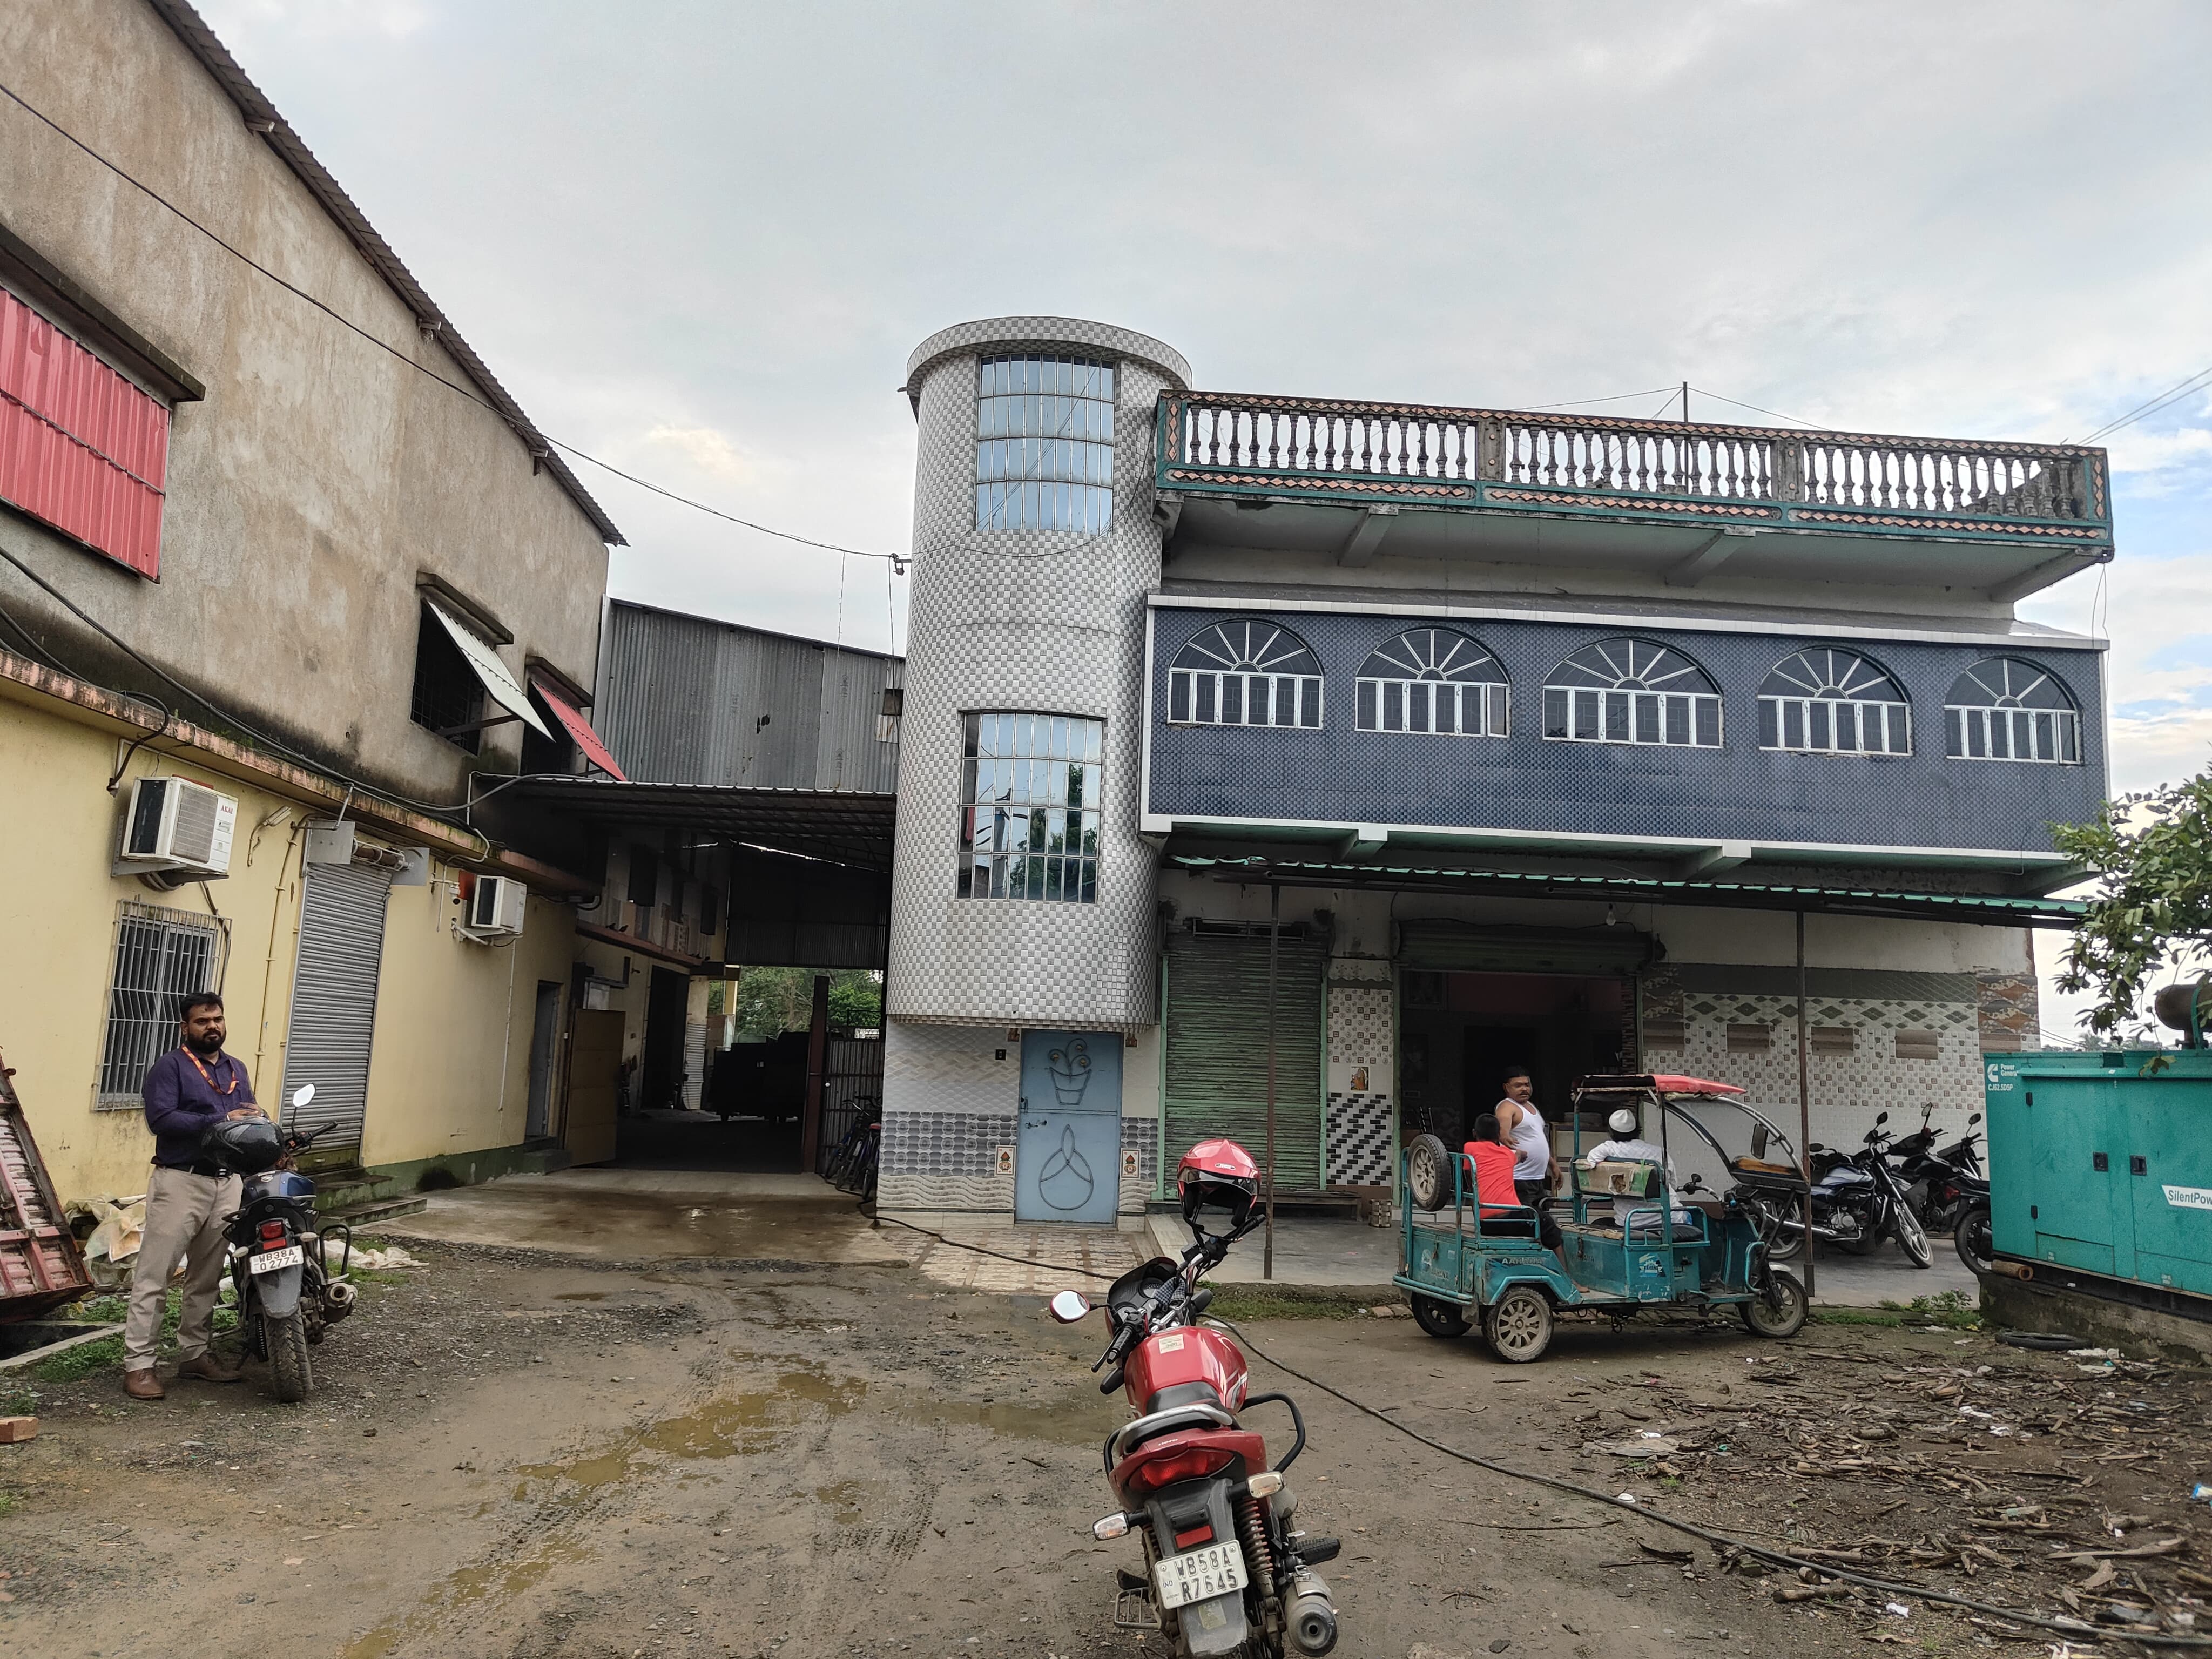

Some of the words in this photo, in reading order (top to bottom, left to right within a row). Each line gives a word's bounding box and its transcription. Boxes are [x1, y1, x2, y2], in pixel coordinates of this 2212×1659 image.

[220, 805, 233, 814] AKAI
[259, 1249, 295, 1263] WB38A
[1175, 1547, 1232, 1579] WB58A
[1163, 1580, 1174, 1588] IND
[1180, 1568, 1238, 1602] R7645
